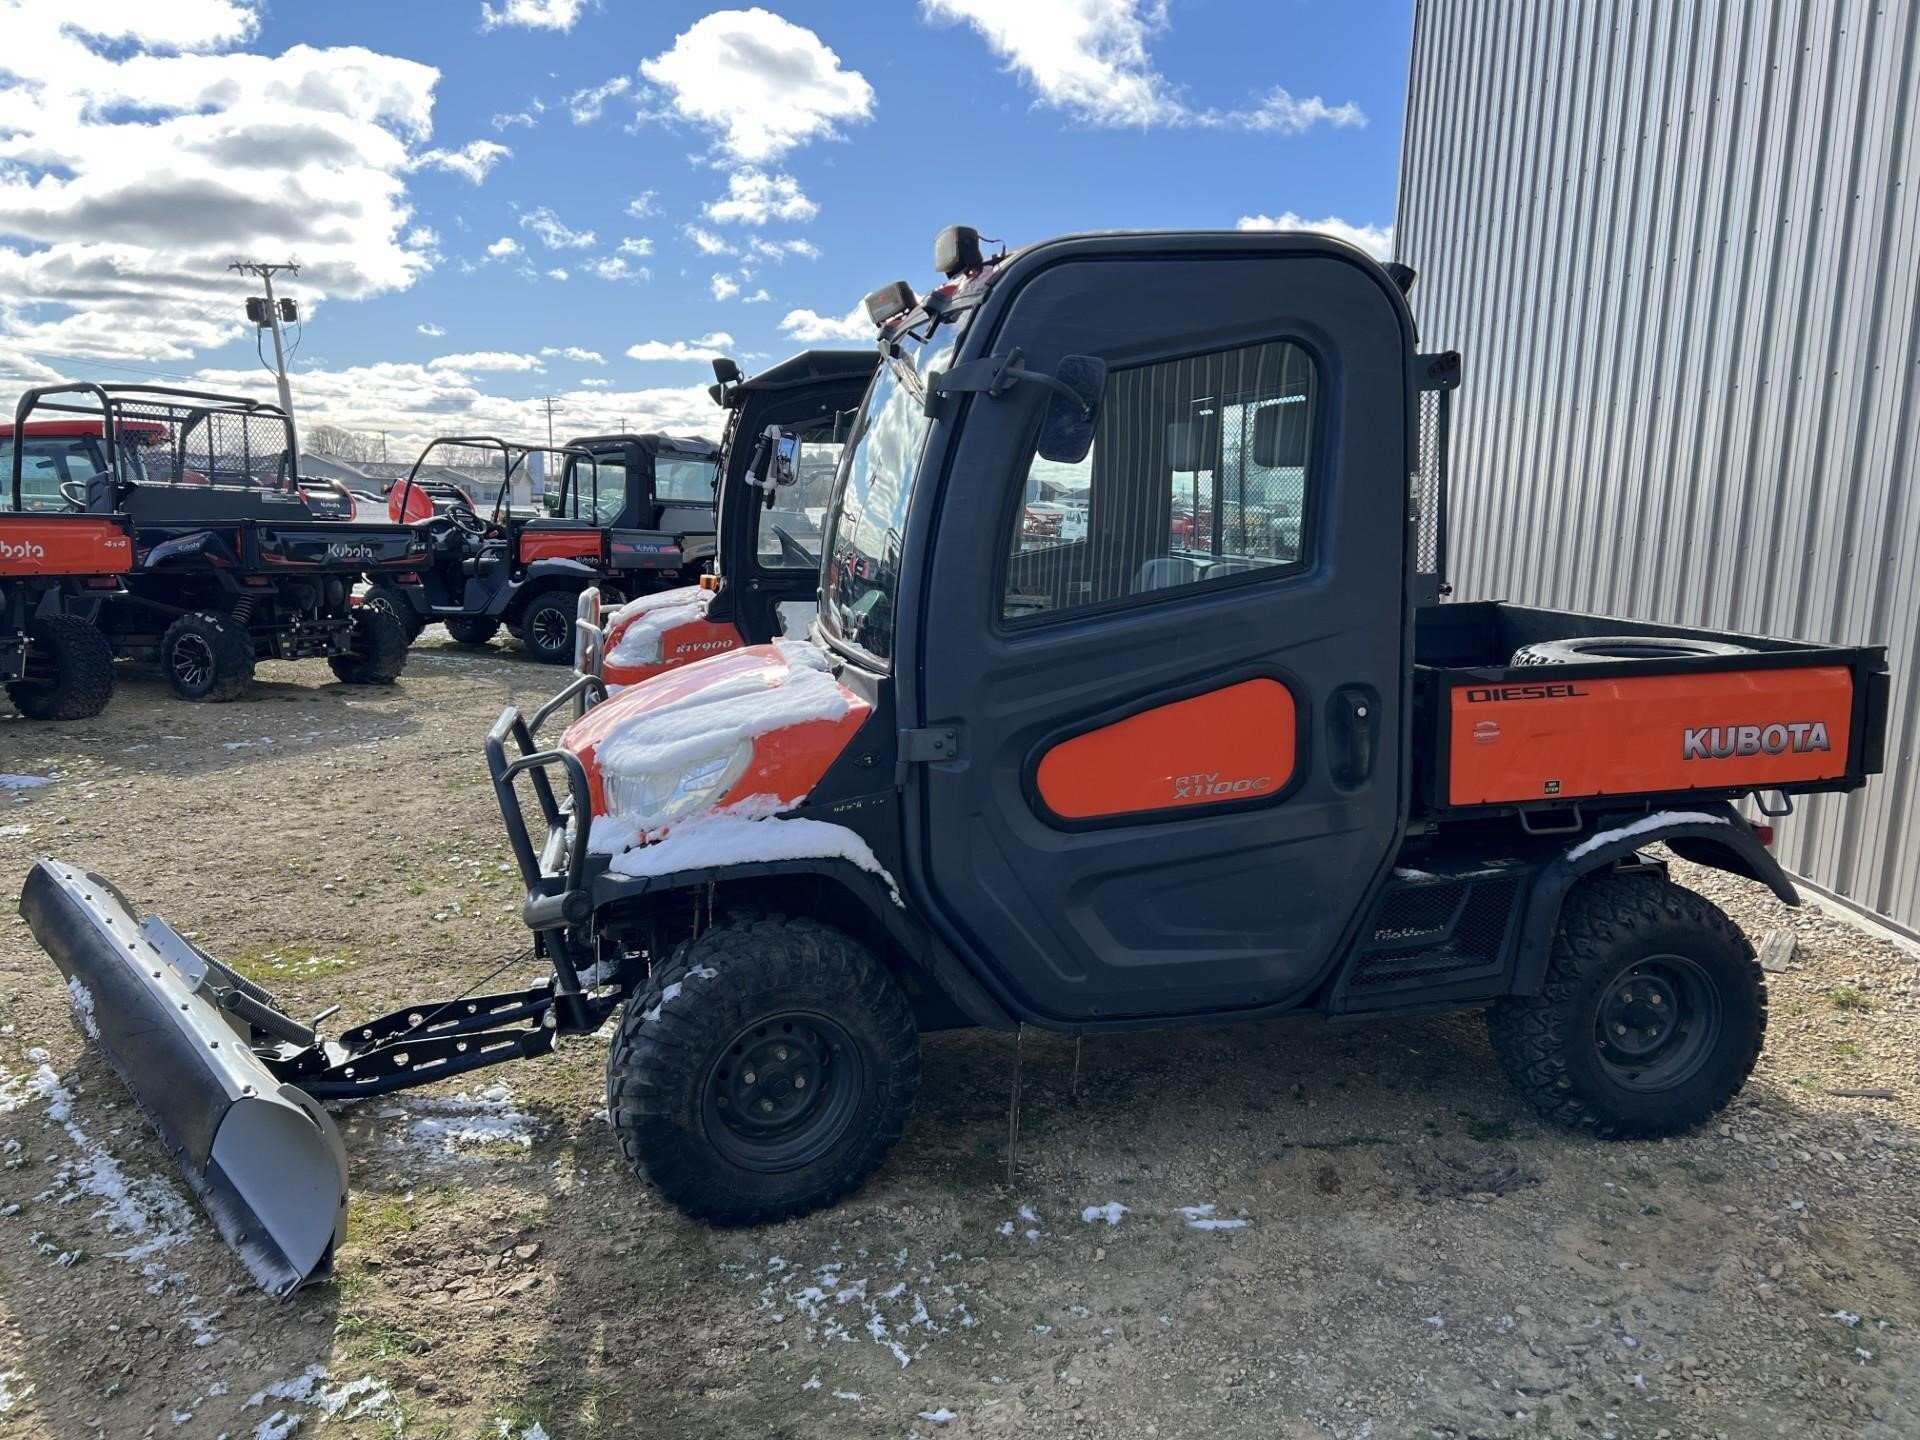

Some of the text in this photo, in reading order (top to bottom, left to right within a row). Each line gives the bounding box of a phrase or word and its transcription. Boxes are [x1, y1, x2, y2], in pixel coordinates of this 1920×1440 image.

[103, 540, 127, 548] 4x4
[327, 543, 373, 558] Kubota
[676, 639, 733, 653] RTV900
[1466, 684, 1590, 703] DIESEL
[1682, 721, 1832, 760] KUBOTA
[1175, 772, 1219, 787] RTV
[1172, 776, 1271, 800] X1100C
